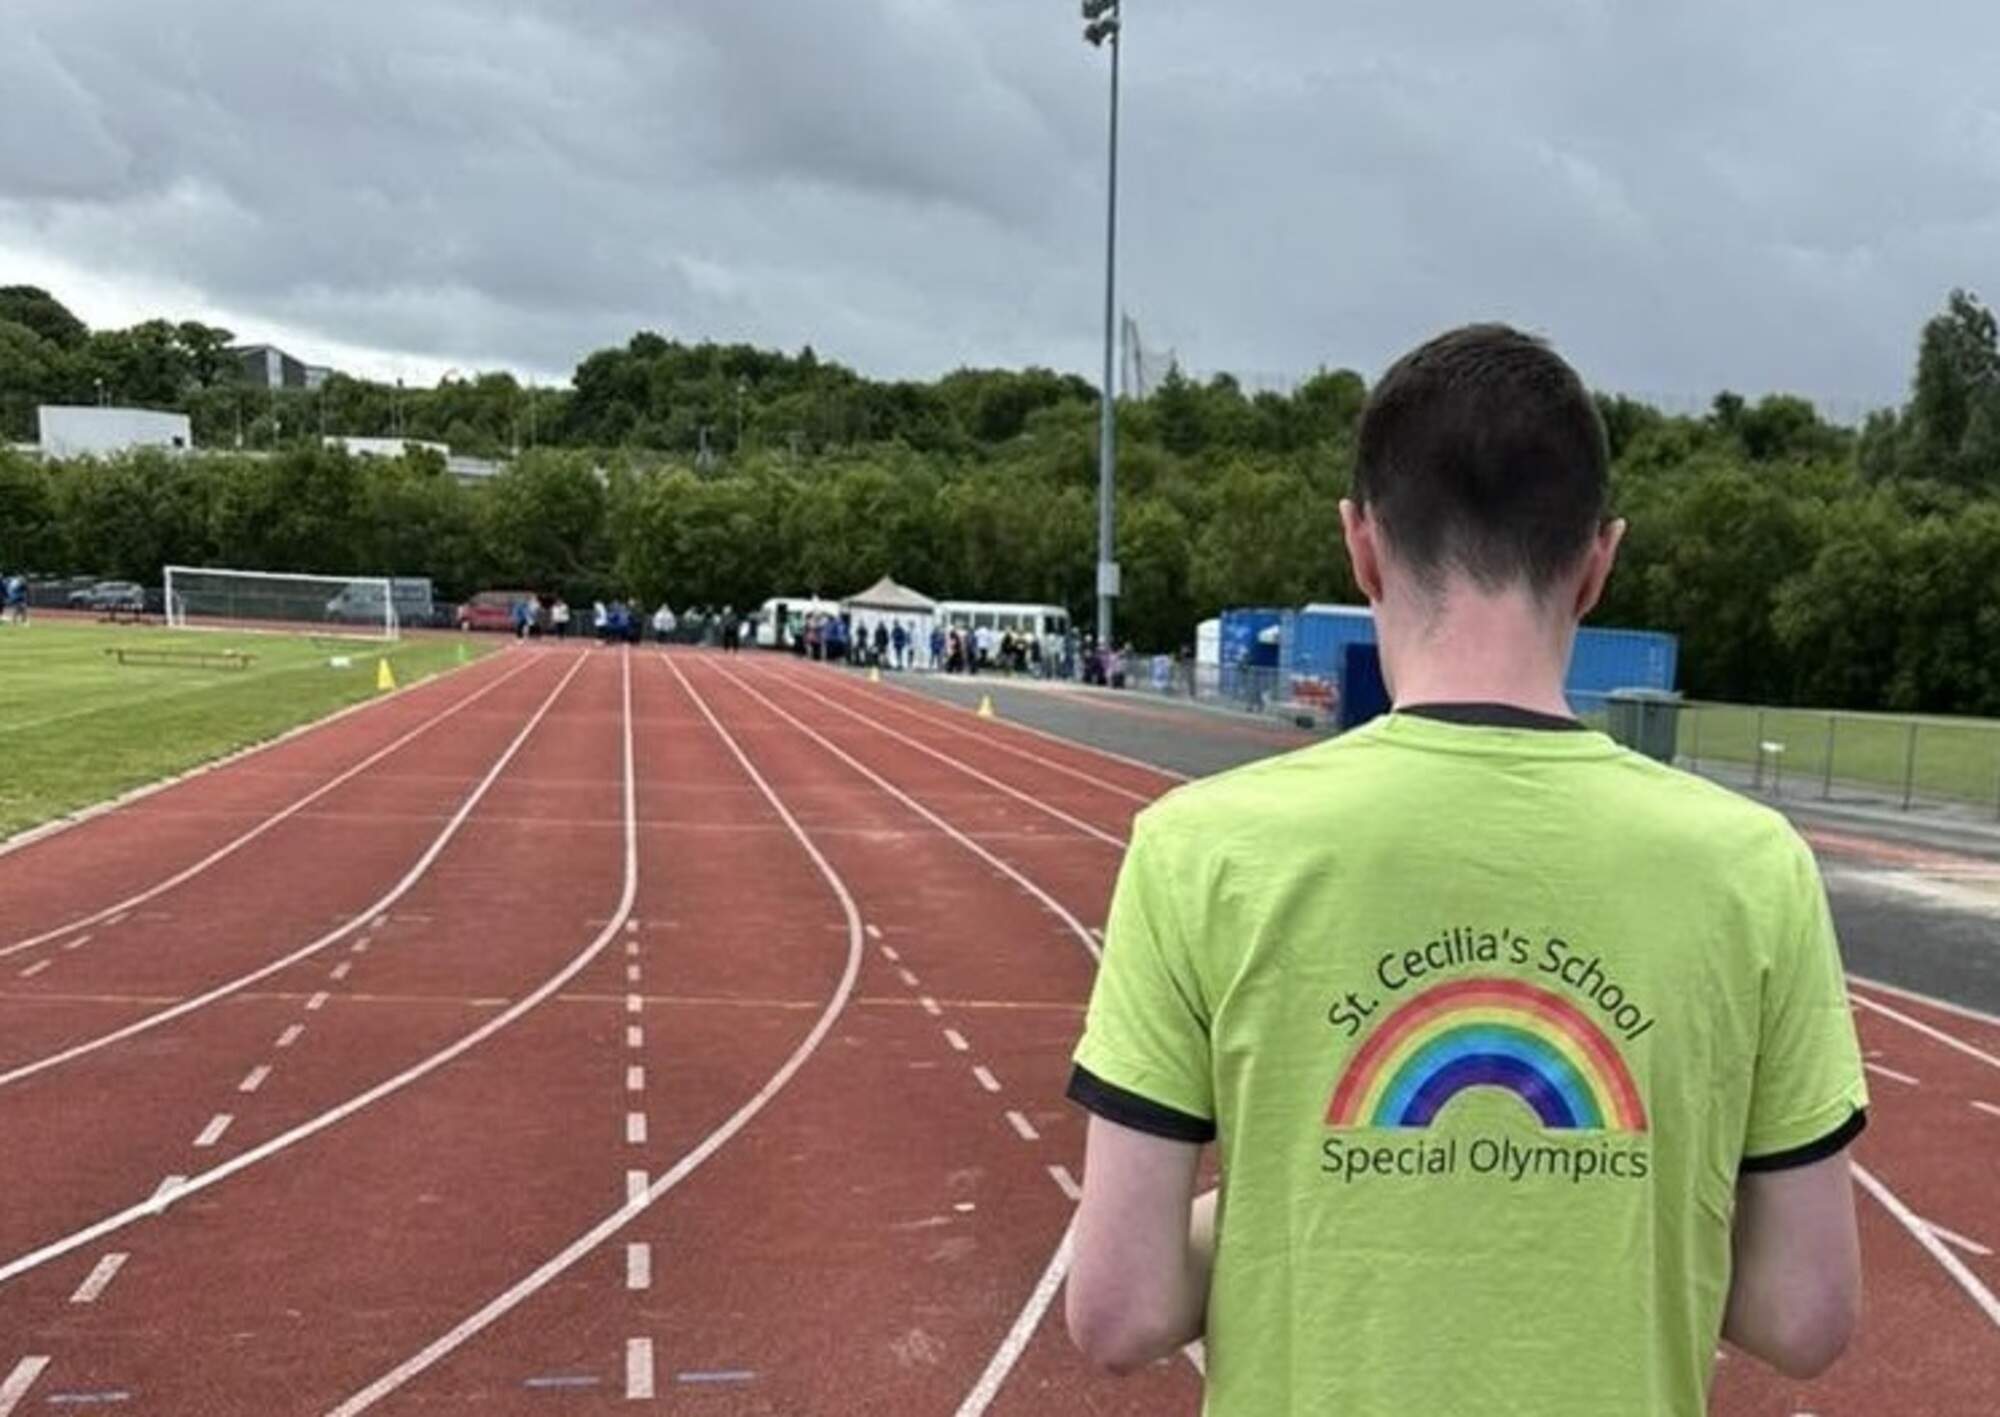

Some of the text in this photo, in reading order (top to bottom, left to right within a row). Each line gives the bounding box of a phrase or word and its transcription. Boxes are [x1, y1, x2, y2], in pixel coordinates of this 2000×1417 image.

[1328, 926, 1655, 1041] St. Cecilia's School
[1321, 1138, 1649, 1184] Special Olympics
